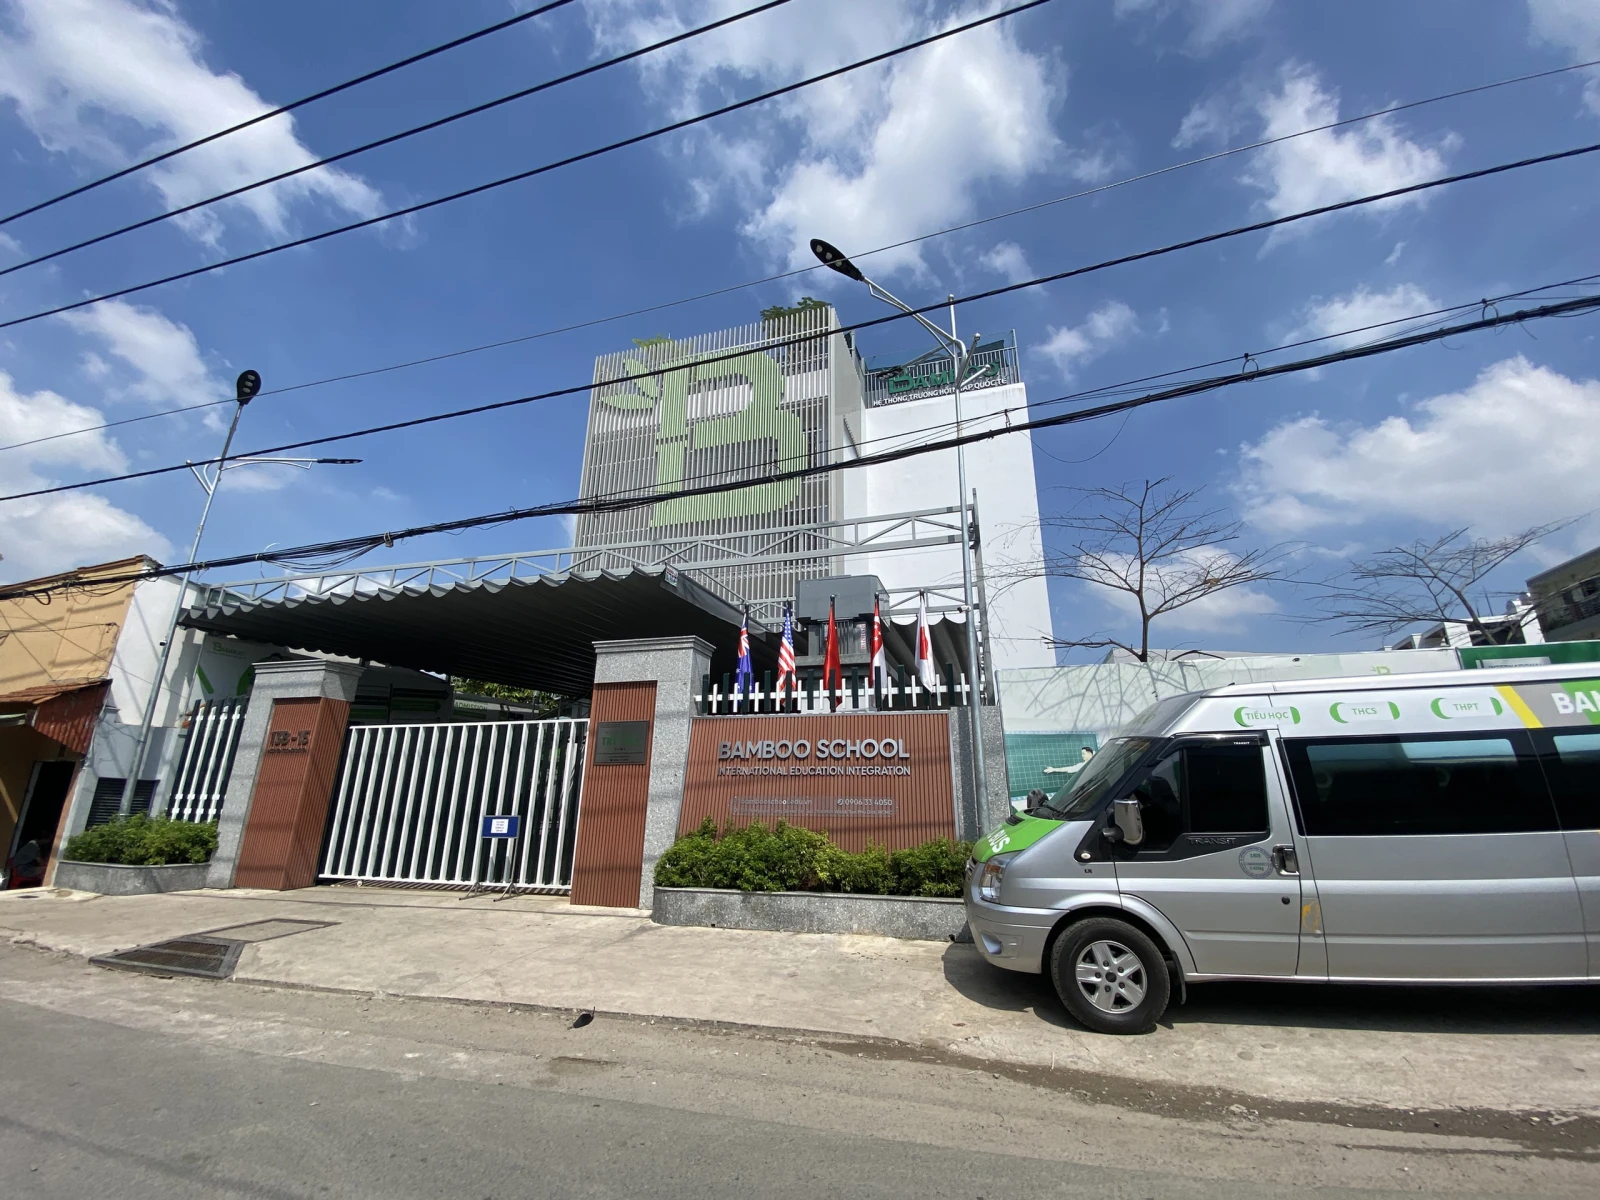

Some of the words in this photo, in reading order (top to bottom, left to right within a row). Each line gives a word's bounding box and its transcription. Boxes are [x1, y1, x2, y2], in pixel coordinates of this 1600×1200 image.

[1351, 707, 1377, 715] THCS
[1453, 702, 1478, 711] THPT
[1268, 711, 1289, 720] HỌC
[718, 739, 811, 760] BAMBOO
[816, 737, 911, 759] SCHOOL
[717, 765, 788, 777] INTERNATIONAL
[789, 765, 844, 776] EDUCATION
[846, 764, 911, 777] INTEGRATION
[845, 798, 863, 806] 0906
[864, 798, 873, 806] 33
[874, 798, 893, 806] 4050
[1187, 837, 1236, 845] TRANSIT
